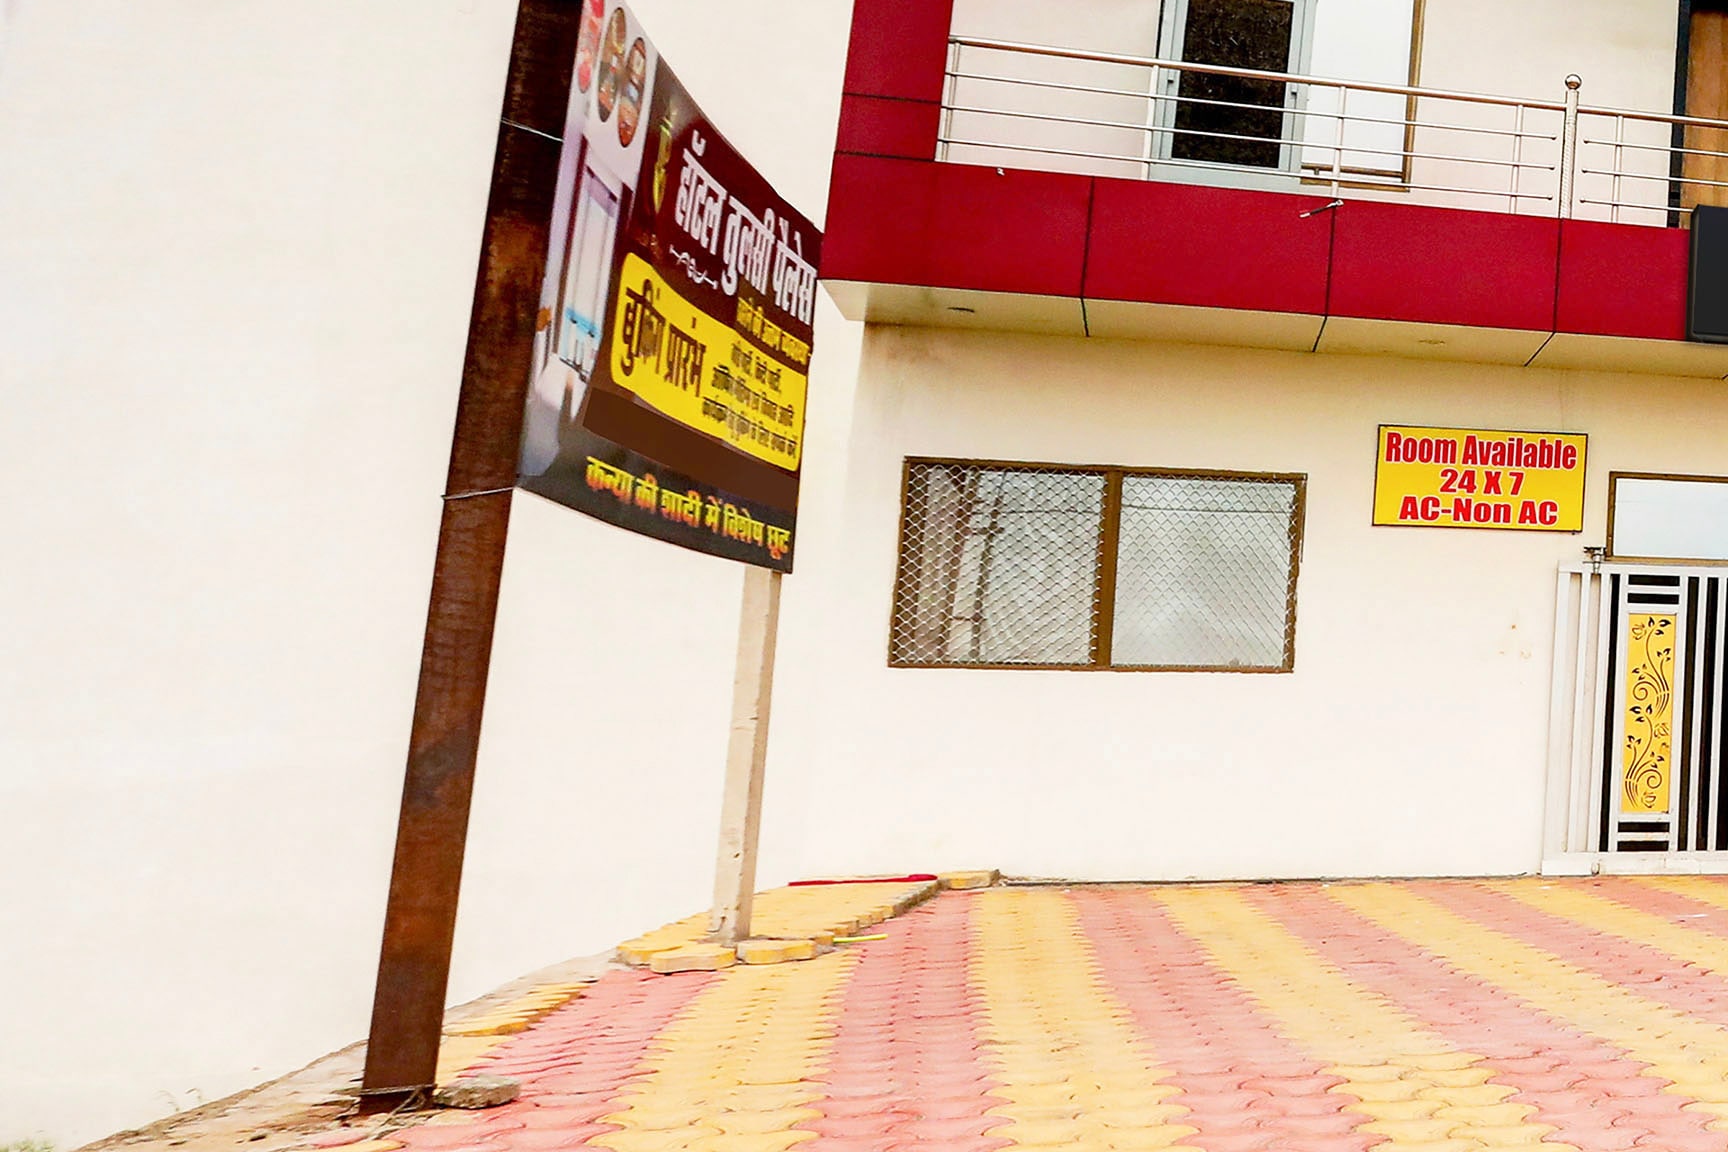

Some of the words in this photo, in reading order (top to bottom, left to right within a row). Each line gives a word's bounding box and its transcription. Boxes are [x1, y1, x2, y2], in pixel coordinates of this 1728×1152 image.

[721, 195, 776, 296] तुलसी
[773, 216, 818, 327] पैलेस
[621, 278, 666, 377] बुकिंग
[1385, 431, 1458, 464] Room
[1461, 435, 1578, 470] Available
[585, 455, 635, 505] कन्या
[634, 472, 659, 515] की
[660, 489, 703, 529] शादी
[1439, 468, 1477, 494] 24
[1483, 470, 1502, 495] X
[1508, 471, 1525, 496] 7
[1398, 496, 1512, 524] AC-Non
[1518, 500, 1559, 526] AC
